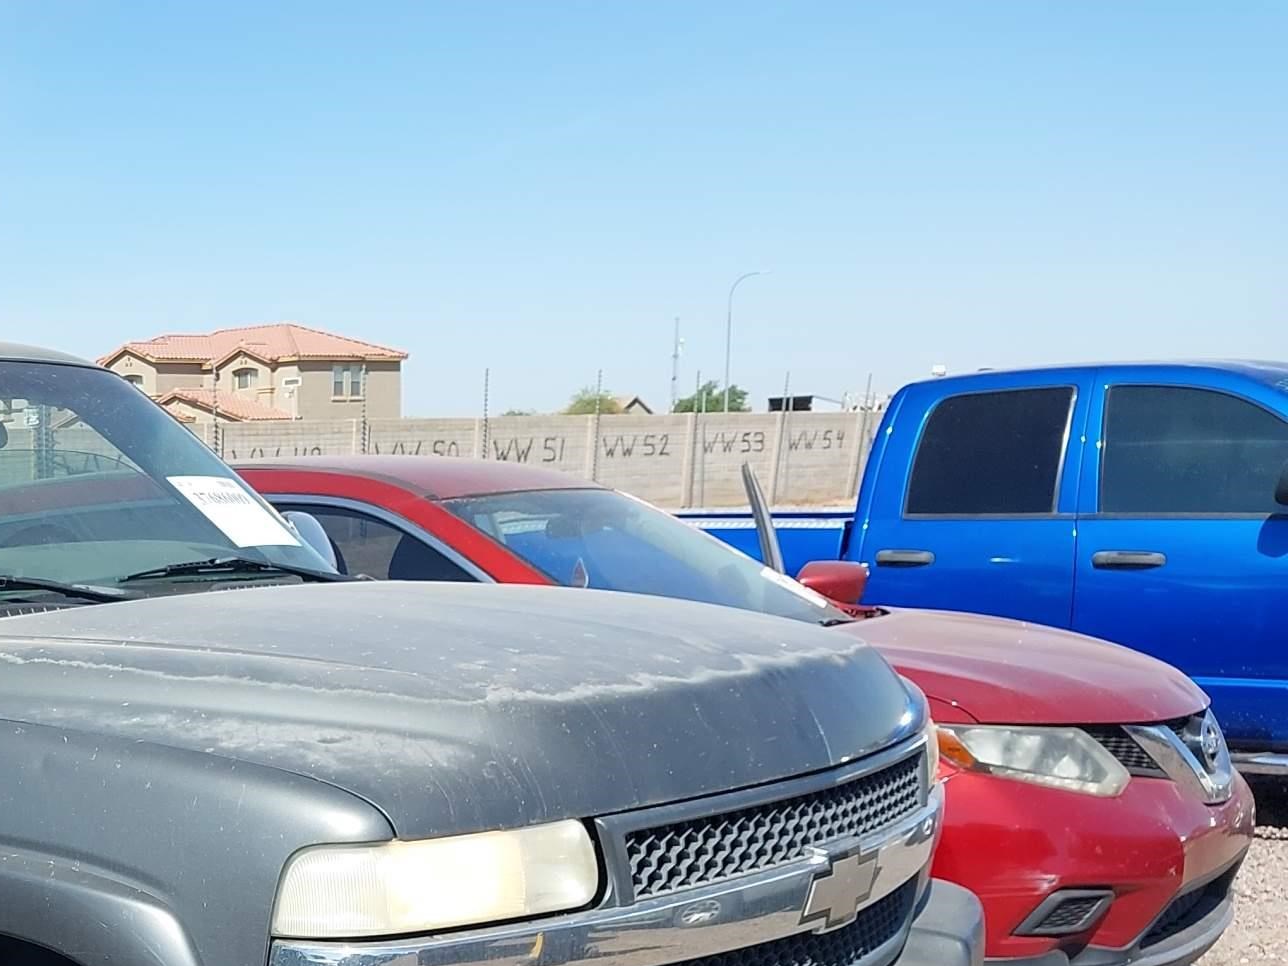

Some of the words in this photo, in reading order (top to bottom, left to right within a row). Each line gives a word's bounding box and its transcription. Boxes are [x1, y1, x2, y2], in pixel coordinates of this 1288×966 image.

[493, 437, 533, 463] WW
[542, 437, 565, 463] 51
[602, 434, 637, 457] WW
[642, 434, 670, 457] 52
[740, 431, 765, 453] 53
[823, 429, 845, 450] 54
